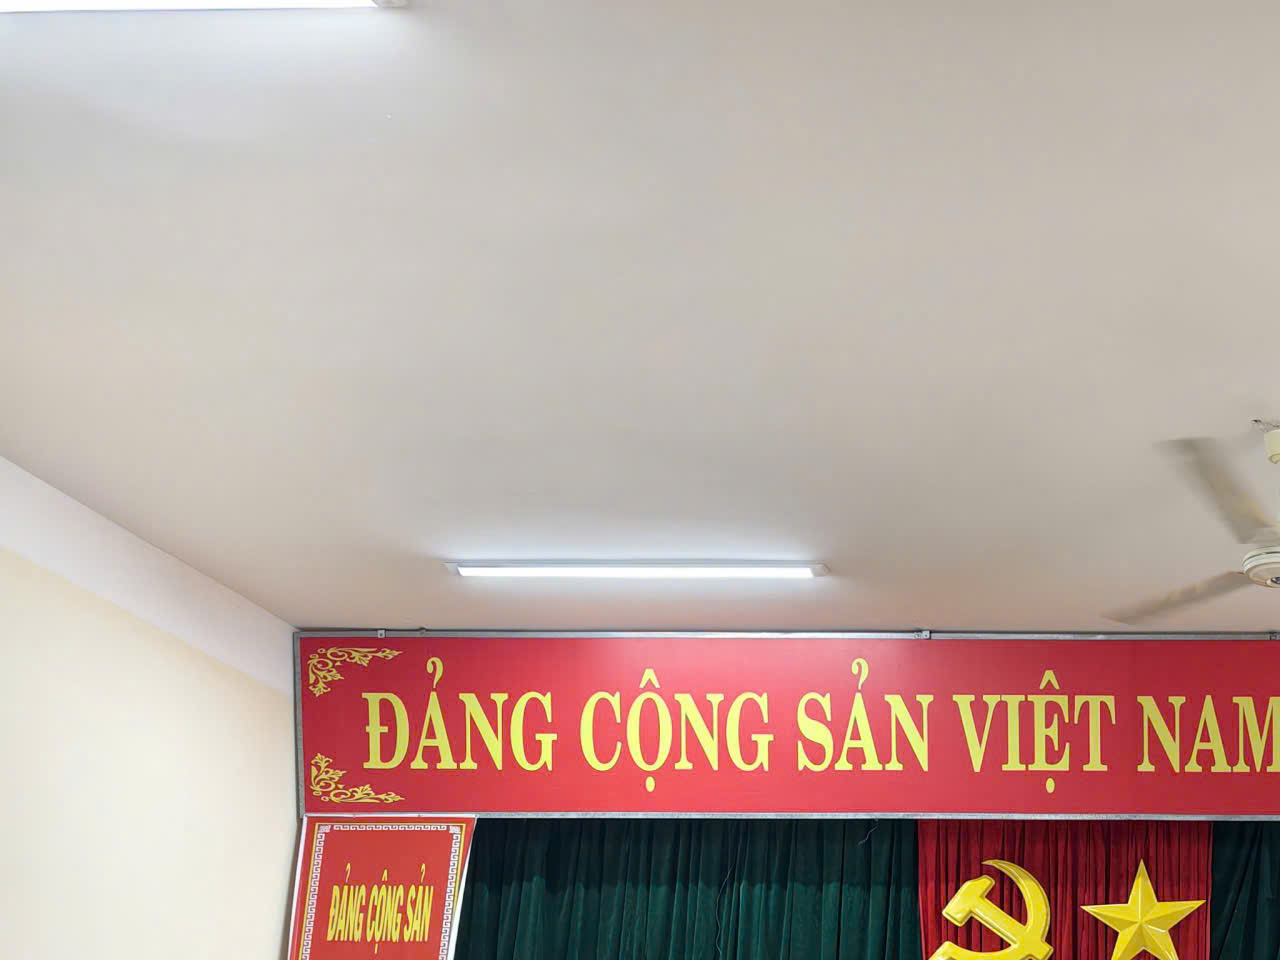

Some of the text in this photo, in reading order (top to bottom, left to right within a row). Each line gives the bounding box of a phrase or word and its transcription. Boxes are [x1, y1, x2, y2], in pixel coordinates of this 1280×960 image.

[362, 657, 557, 772] ĐẢNG
[580, 668, 774, 792] CỘNG
[797, 658, 931, 772] SẢN
[952, 670, 1115, 792] VIỆT
[327, 863, 434, 953] ĐẢNG CỘNG SẢN
